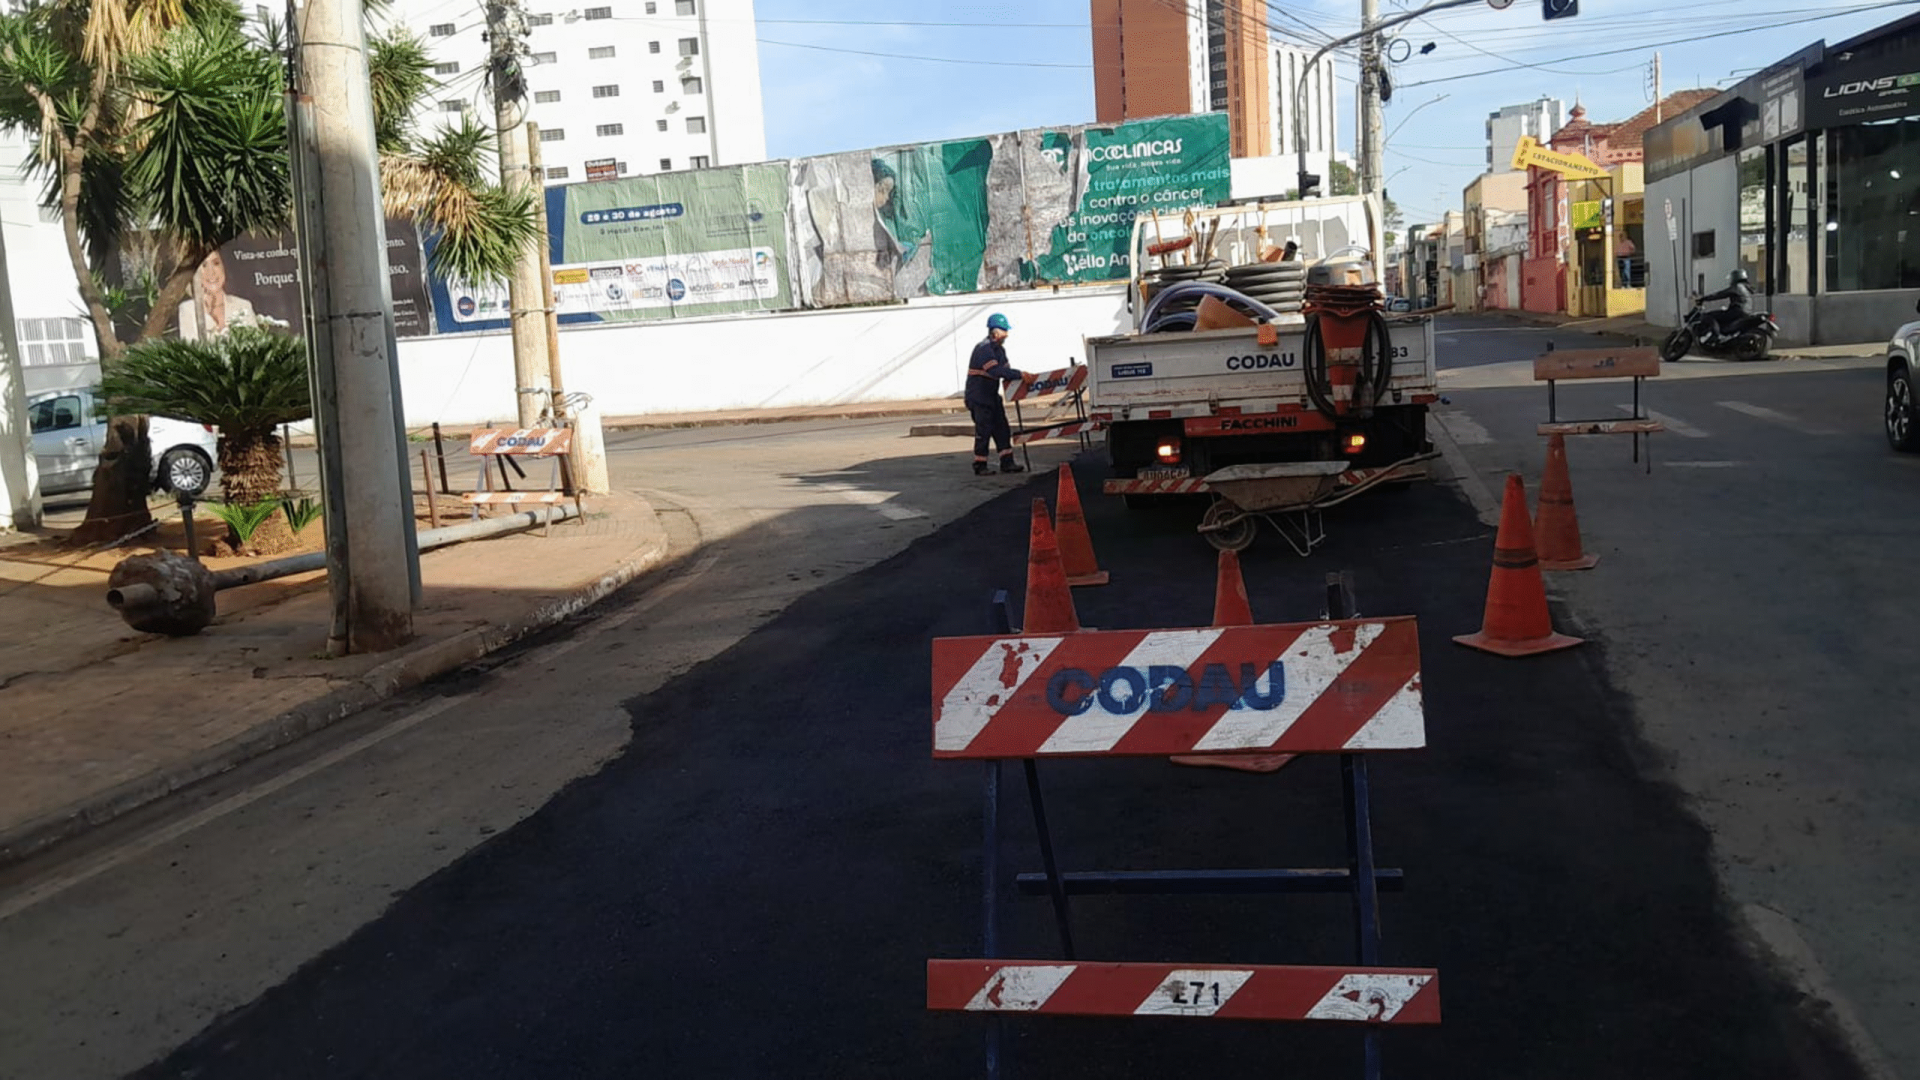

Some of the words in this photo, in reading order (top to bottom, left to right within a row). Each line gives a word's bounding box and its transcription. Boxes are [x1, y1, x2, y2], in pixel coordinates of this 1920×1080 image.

[1824, 75, 1898, 98] LIONS
[1532, 152, 1599, 175] ESTACIONAMENTO
[1094, 172, 1188, 191] tratamentos
[1191, 167, 1231, 182] mais
[1089, 193, 1137, 209] contra
[1140, 193, 1150, 204] o
[1153, 187, 1204, 202] câncer
[611, 210, 625, 220] 30
[1067, 231, 1087, 243] da
[254, 271, 295, 288] Porque
[1226, 353, 1295, 370] CODAU
[1028, 378, 1068, 392] CODAU
[1221, 417, 1297, 430] FACCHINI
[496, 436, 546, 447] CODAU
[1045, 660, 1286, 716] CODAU
